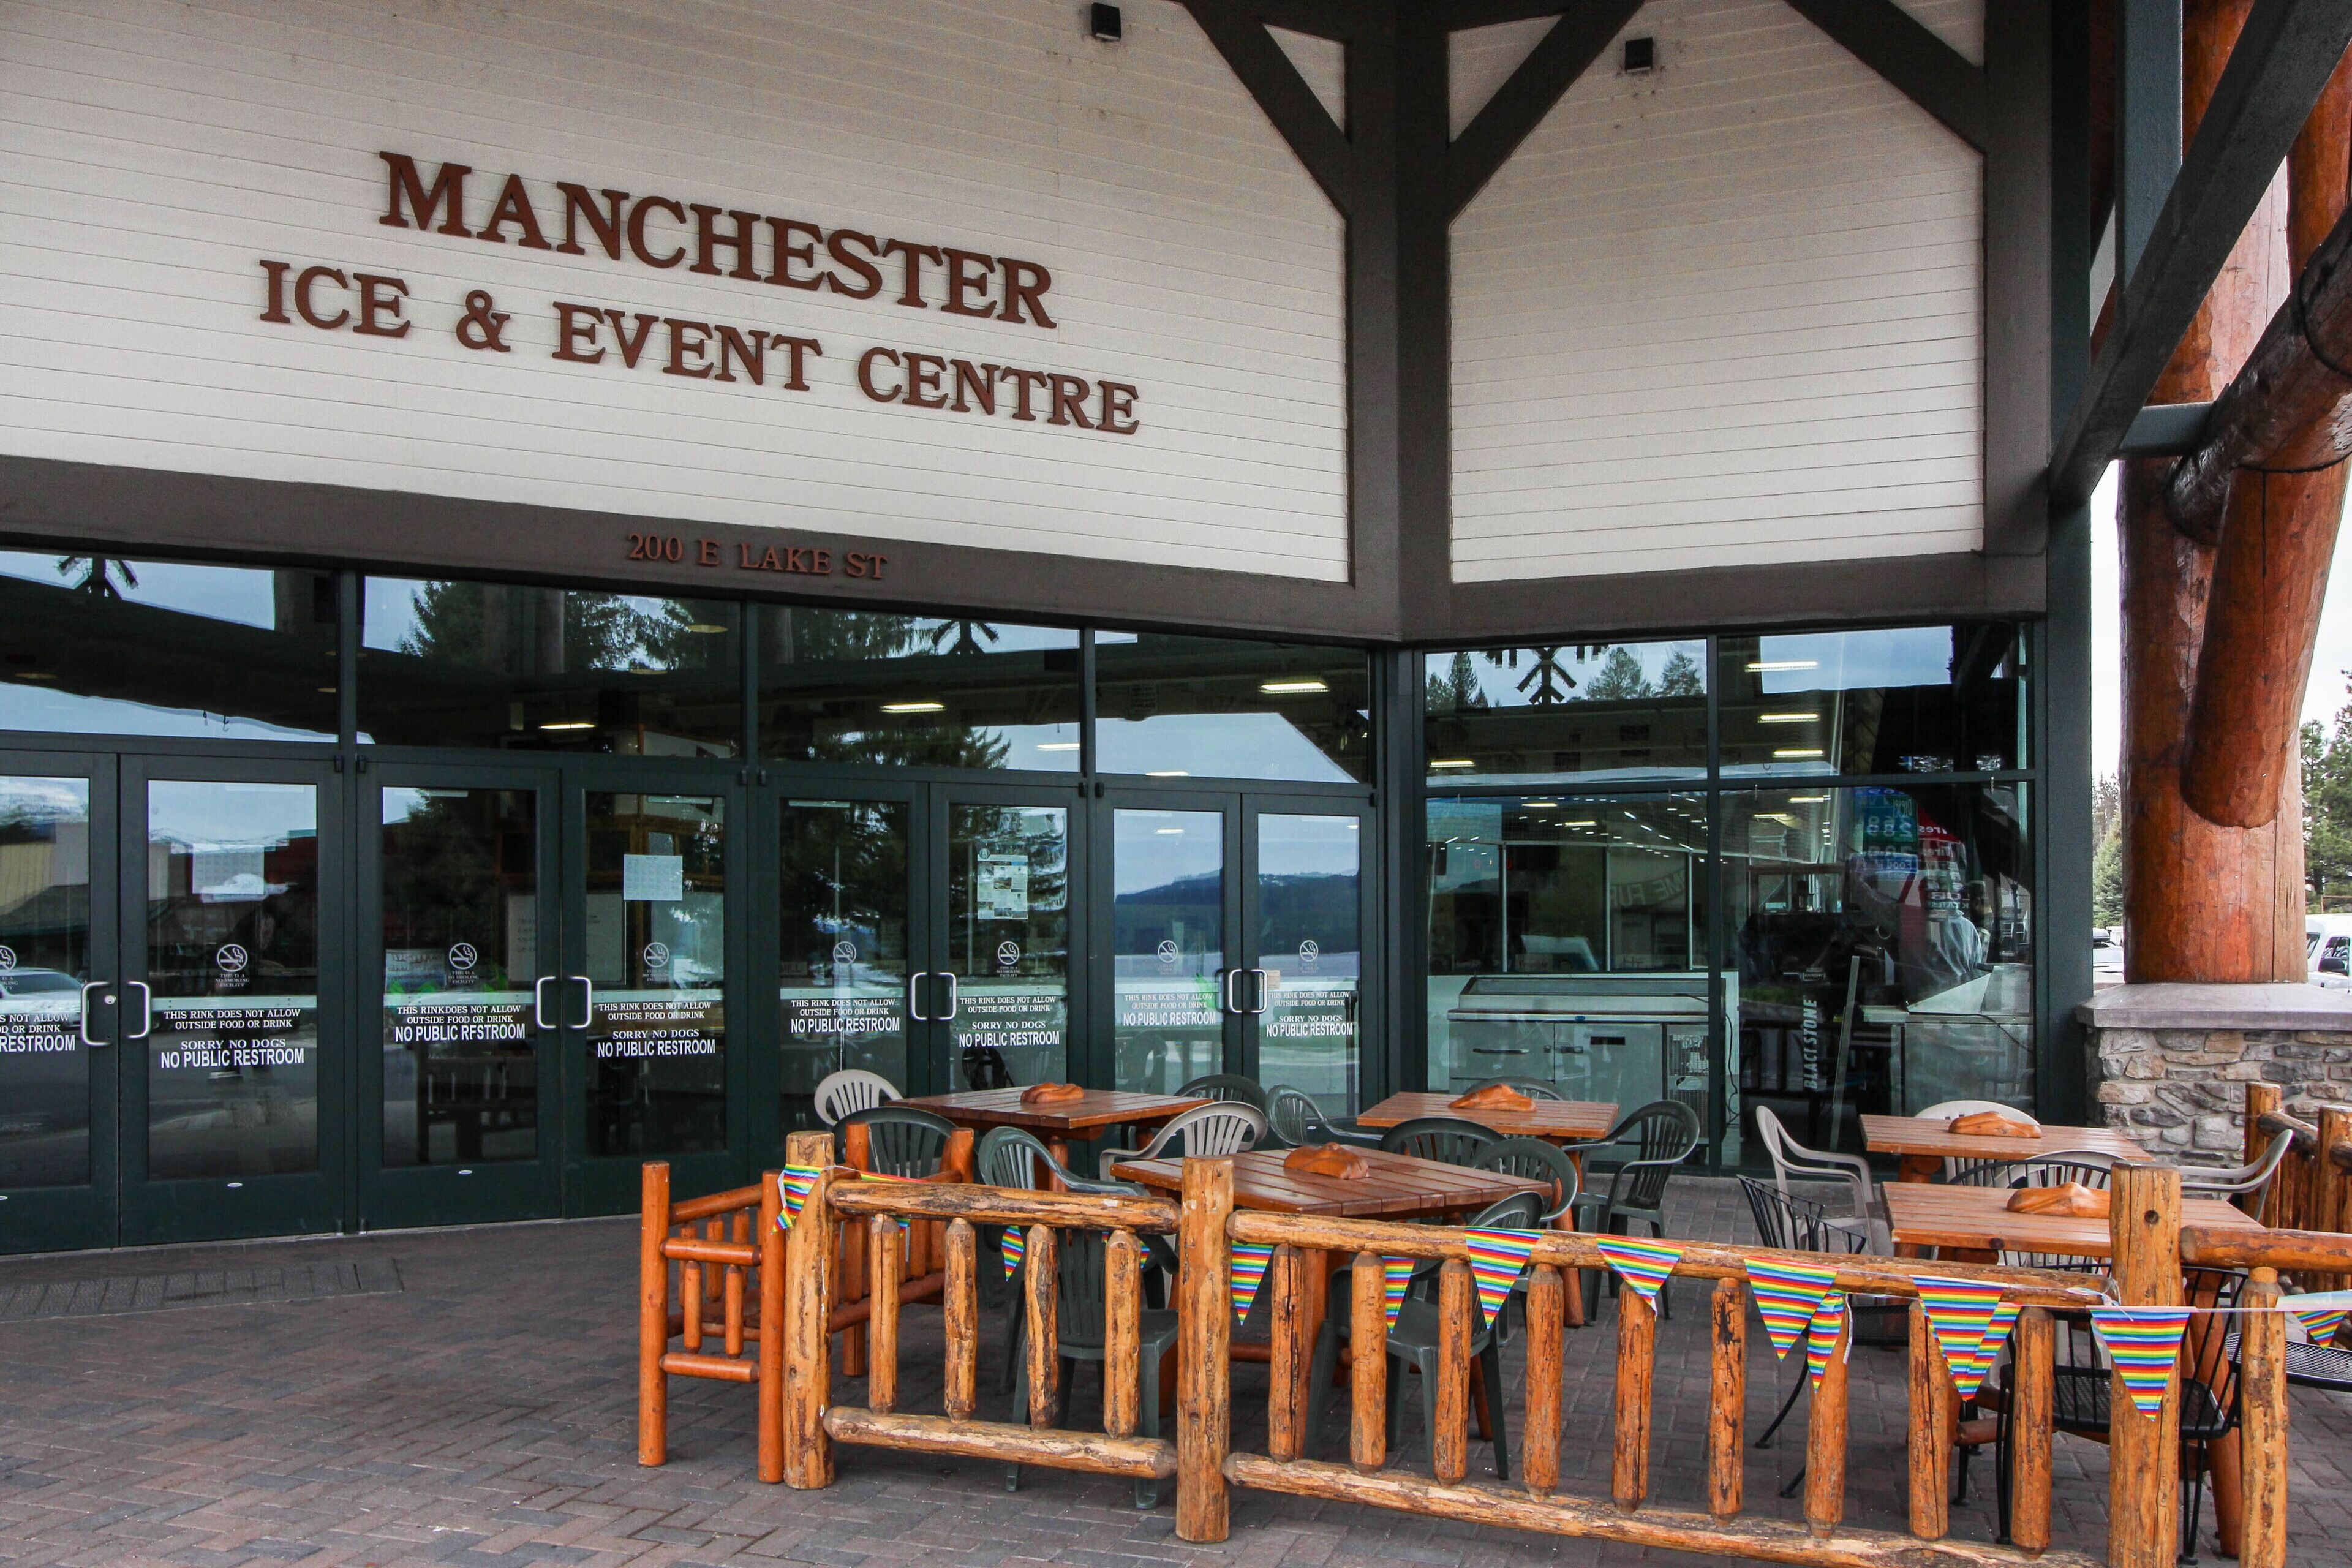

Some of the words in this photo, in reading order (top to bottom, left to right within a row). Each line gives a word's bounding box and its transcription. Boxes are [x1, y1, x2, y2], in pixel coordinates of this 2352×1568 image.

[379, 151, 1057, 328] MANCHESTER
[260, 260, 410, 338] ICE
[456, 289, 511, 352] &
[552, 301, 823, 391] EVENT
[858, 347, 1140, 434] CENTRE
[627, 532, 683, 562] 200
[698, 538, 720, 566] E
[738, 542, 832, 575] LAKE
[845, 551, 888, 579] ST
[175, 1021, 216, 1030] OUTSIDE
[263, 1019, 292, 1028] DRINK
[791, 1019, 805, 1033] NO
[809, 1018, 843, 1032] PUBLIC
[846, 1017, 900, 1031] RESTROOM
[1123, 1013, 1135, 1026] NO
[1138, 1012, 1167, 1025] PUBLIC
[1170, 1011, 1216, 1025] RESTROOM
[395, 1026, 412, 1042] NO
[417, 1025, 458, 1041] PUBLIC
[671, 1029, 699, 1038] DOGS
[1267, 1025, 1278, 1037] NO
[1280, 1023, 1308, 1036] PUBLIC
[1310, 1023, 1352, 1036] RESTROOM
[0, 1035, 75, 1052] RESTROOM
[181, 1041, 224, 1050] SORRY
[229, 1040, 246, 1049] NO
[252, 1039, 285, 1048] DOGS
[959, 1033, 972, 1047] NO
[975, 1033, 1007, 1047] PUBLIC
[1010, 1031, 1059, 1046] RESTROOM
[597, 1042, 612, 1057] NO
[616, 1041, 654, 1057] PUBLIC
[657, 1039, 715, 1055] RESTROOM
[161, 1052, 180, 1068] NO
[184, 1050, 229, 1068] PUBLIC
[234, 1048, 304, 1065] RESTROOM
